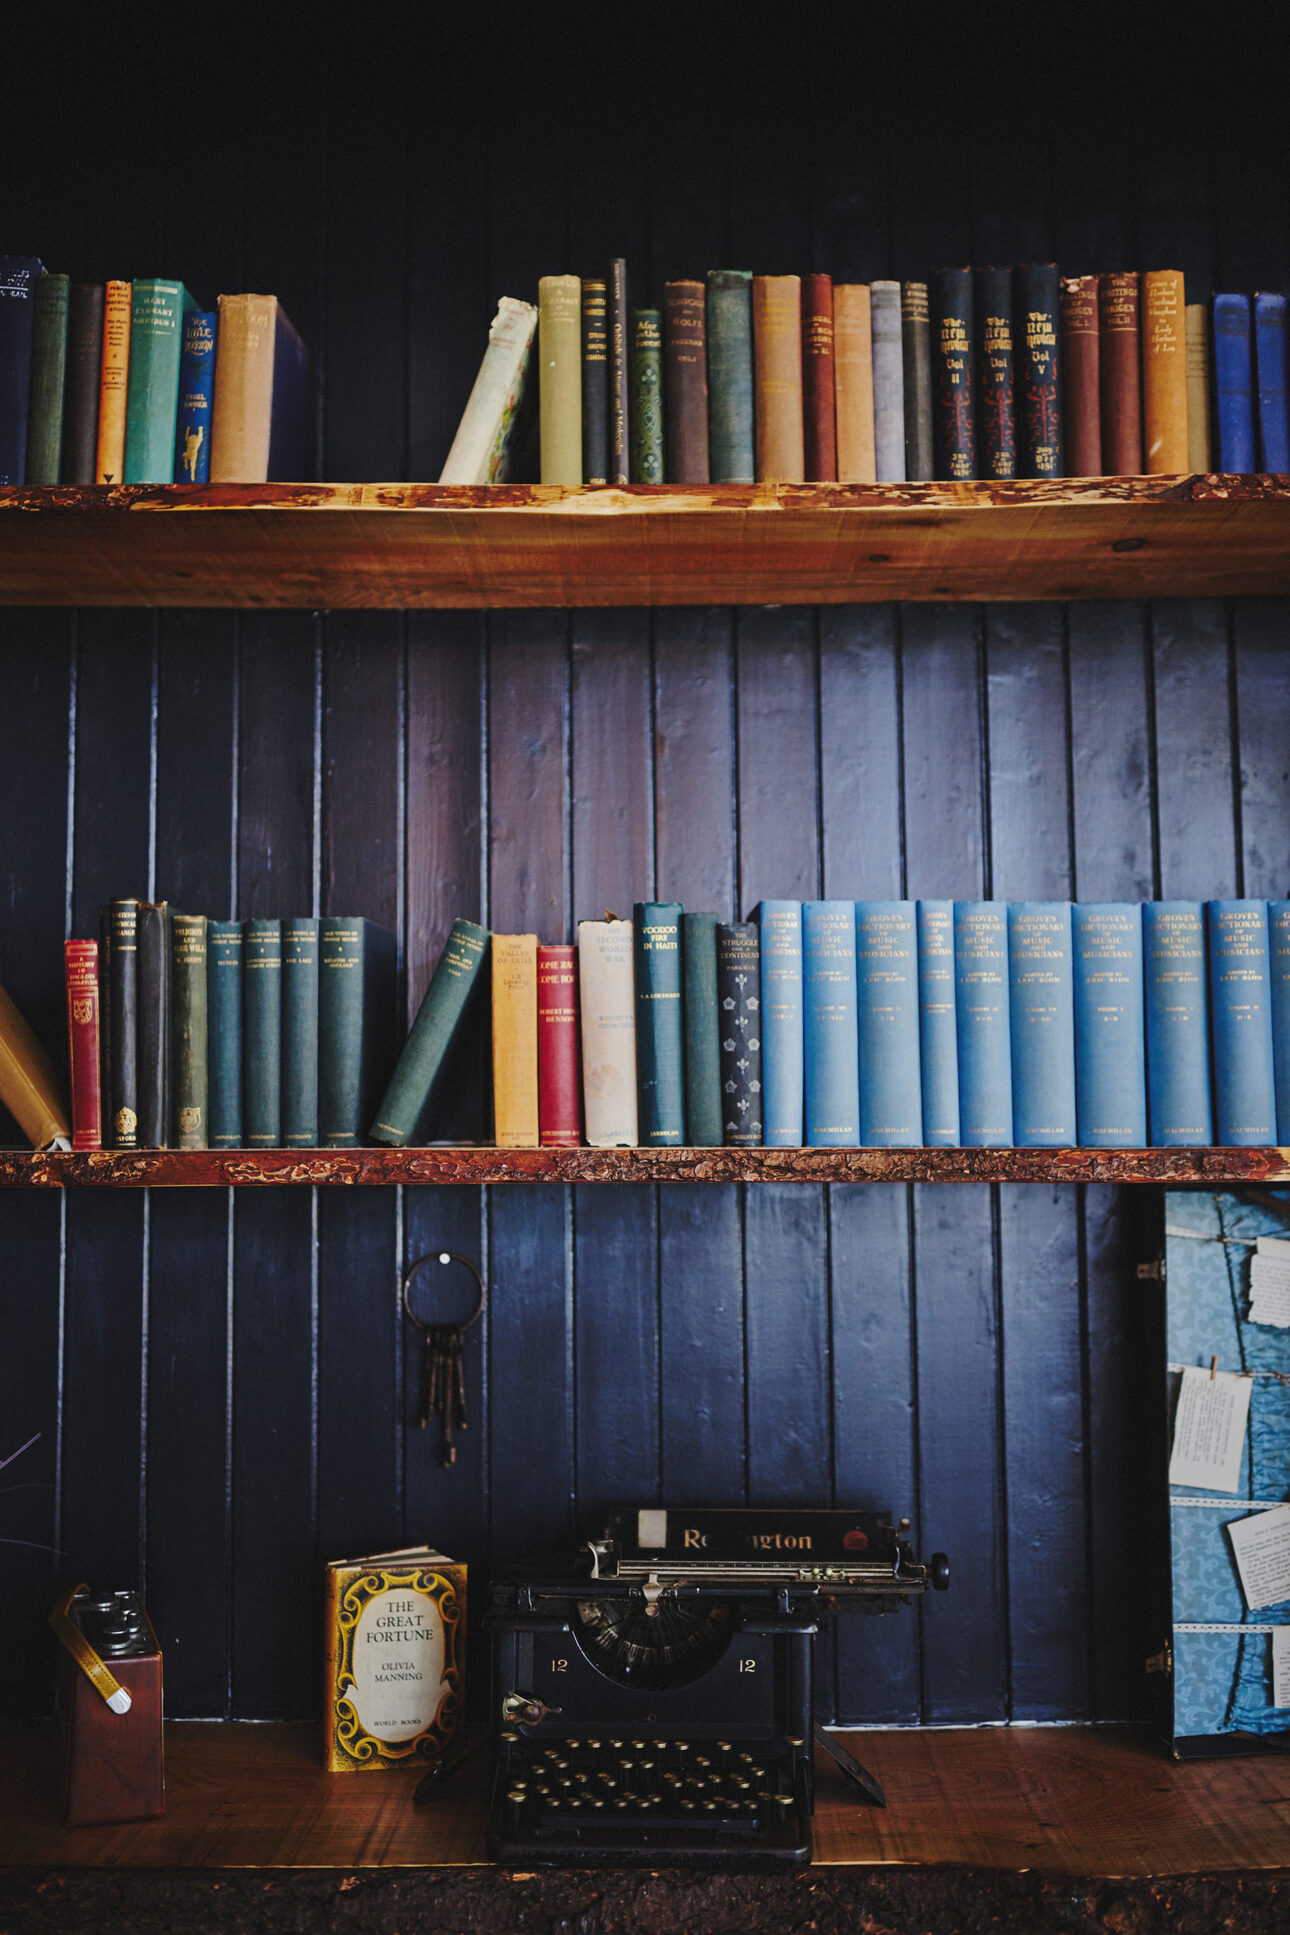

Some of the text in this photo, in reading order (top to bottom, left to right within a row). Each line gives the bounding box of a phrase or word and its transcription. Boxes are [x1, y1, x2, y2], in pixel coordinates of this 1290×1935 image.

[641, 925, 678, 935] VOODOO
[651, 934, 668, 942] FIRE
[868, 936, 900, 945] MUSIC
[964, 936, 997, 945] MUSIC
[1022, 937, 1054, 945] MUSIC
[1091, 936, 1123, 945] MUSIC
[1161, 936, 1193, 945] MUSIC
[1224, 935, 1257, 943] MUSIC
[643, 941, 678, 950] IN HAITI
[722, 939, 759, 948] STRUGGLE
[720, 952, 760, 960] CONTINENT
[385, 1600, 416, 1614] THE
[375, 1614, 425, 1629] GREAT
[365, 1628, 435, 1644] FORTUNE
[380, 1661, 416, 1673] OLIVIA
[551, 1659, 569, 1673] 12
[738, 1659, 757, 1673] 12
[373, 1672, 424, 1684] MANNING
[372, 1717, 422, 1728] WORLD BOOKS
